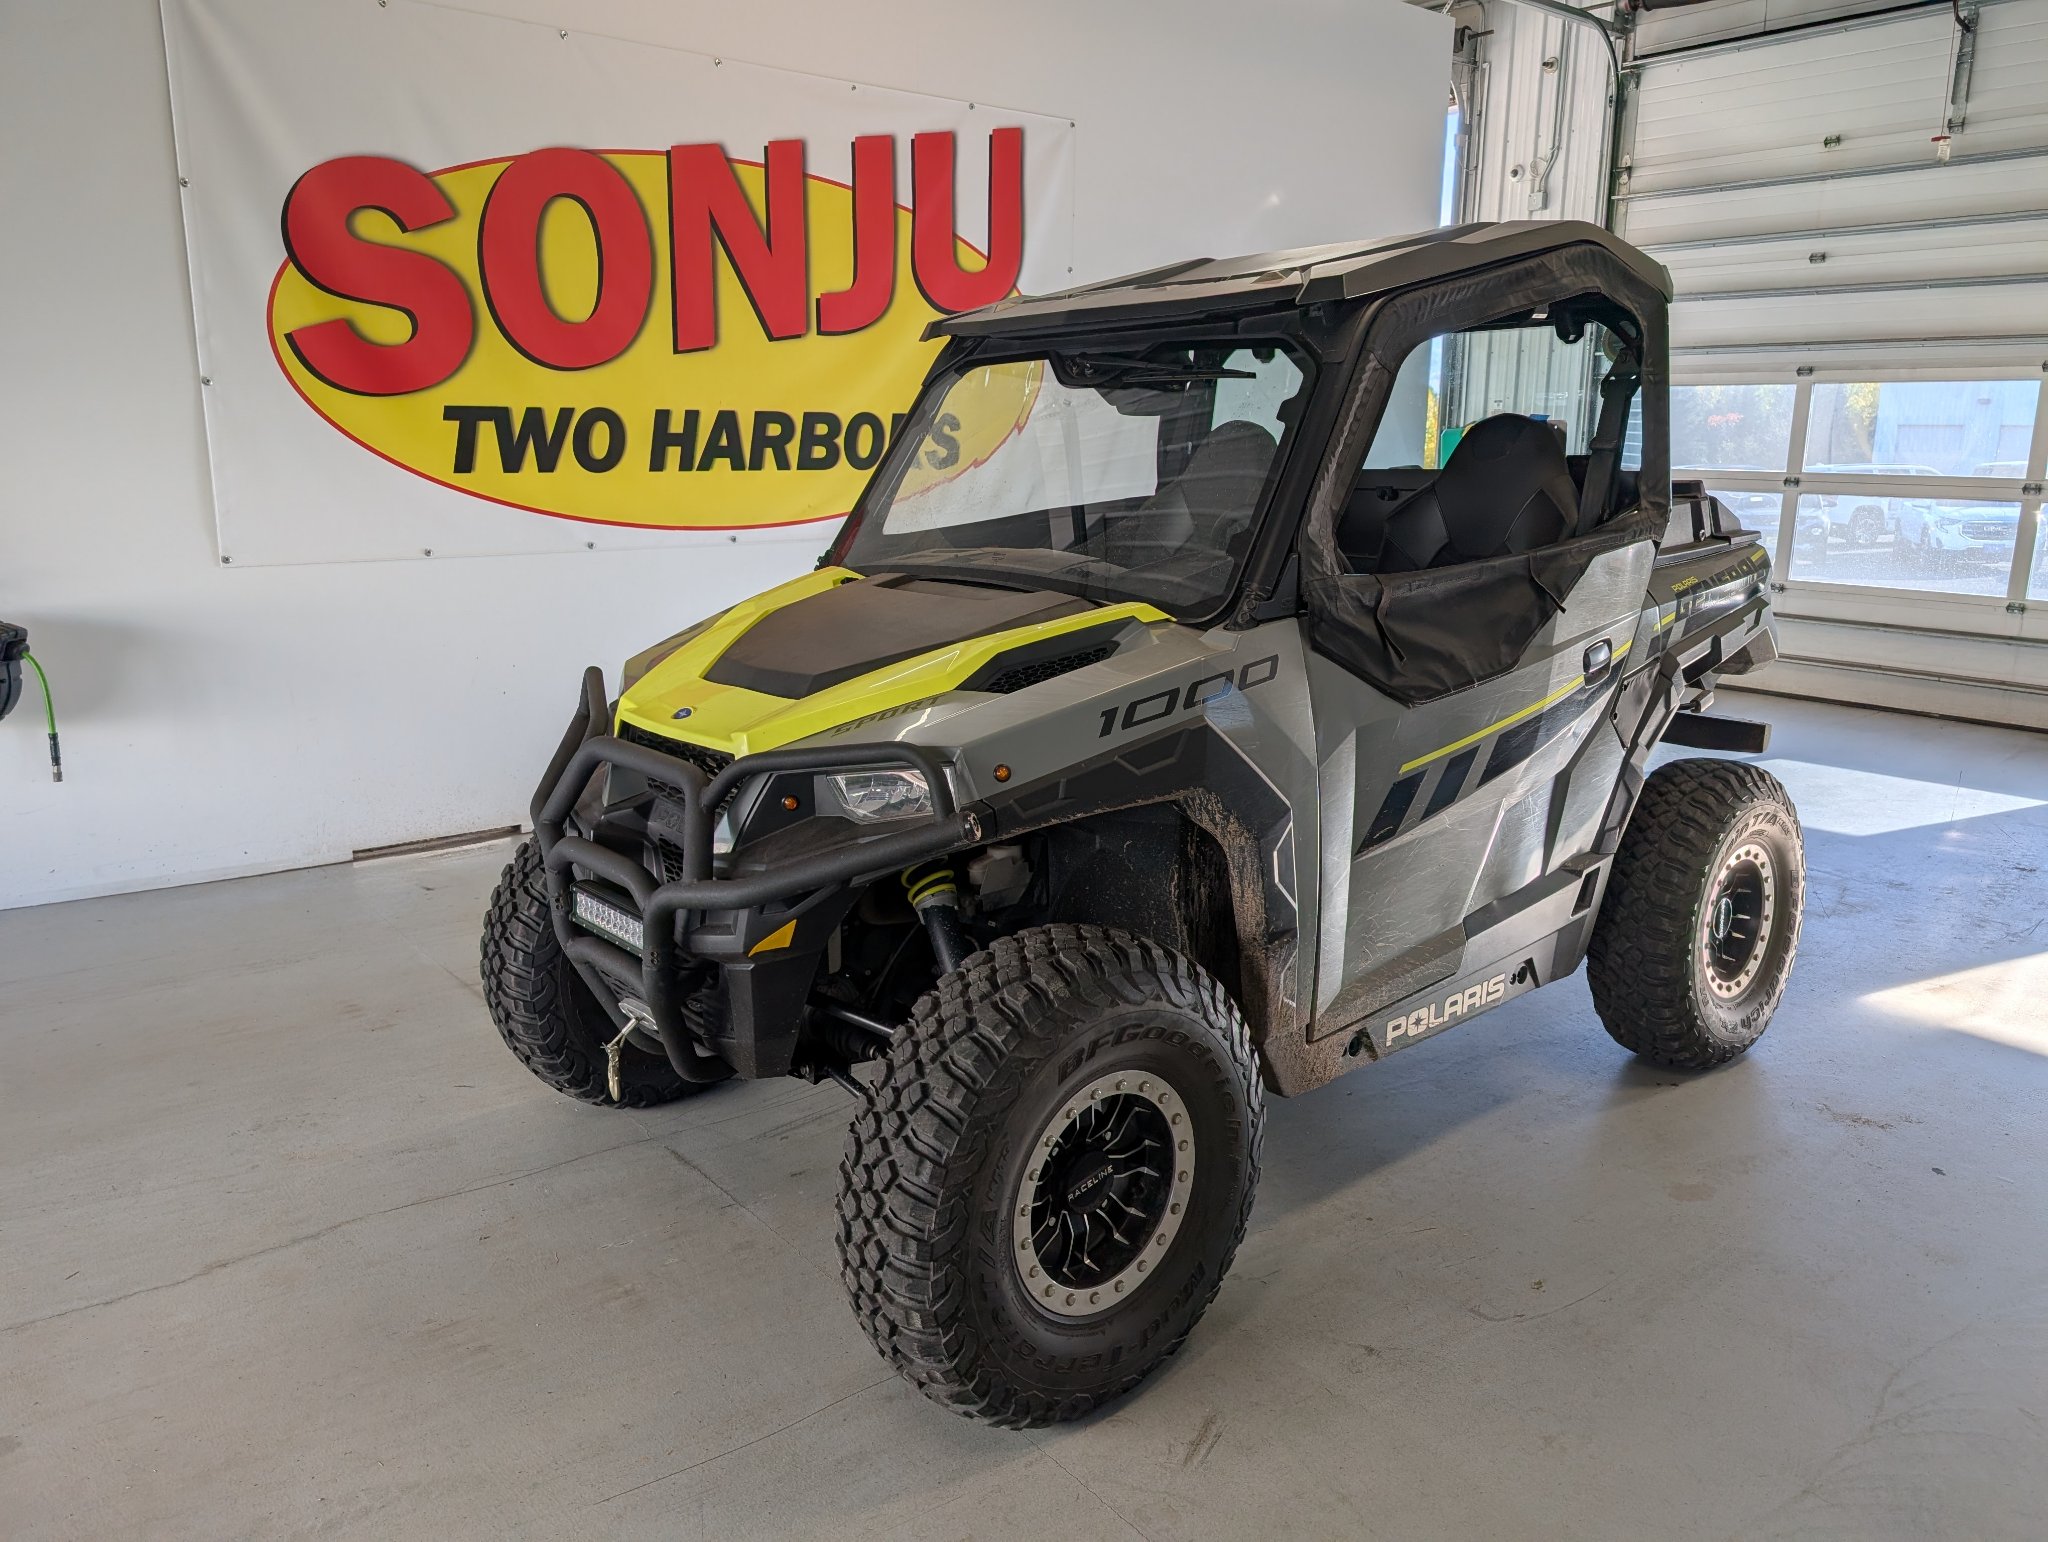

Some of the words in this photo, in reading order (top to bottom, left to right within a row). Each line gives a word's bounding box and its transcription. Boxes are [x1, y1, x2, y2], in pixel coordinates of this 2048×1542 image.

[282, 127, 1023, 396] SONJU
[443, 405, 627, 474] TWO
[831, 694, 946, 738] SPORT
[1098, 654, 1279, 738] 1000
[1385, 973, 1506, 1047] POLARIS
[1067, 1164, 1114, 1203] RACELINE
